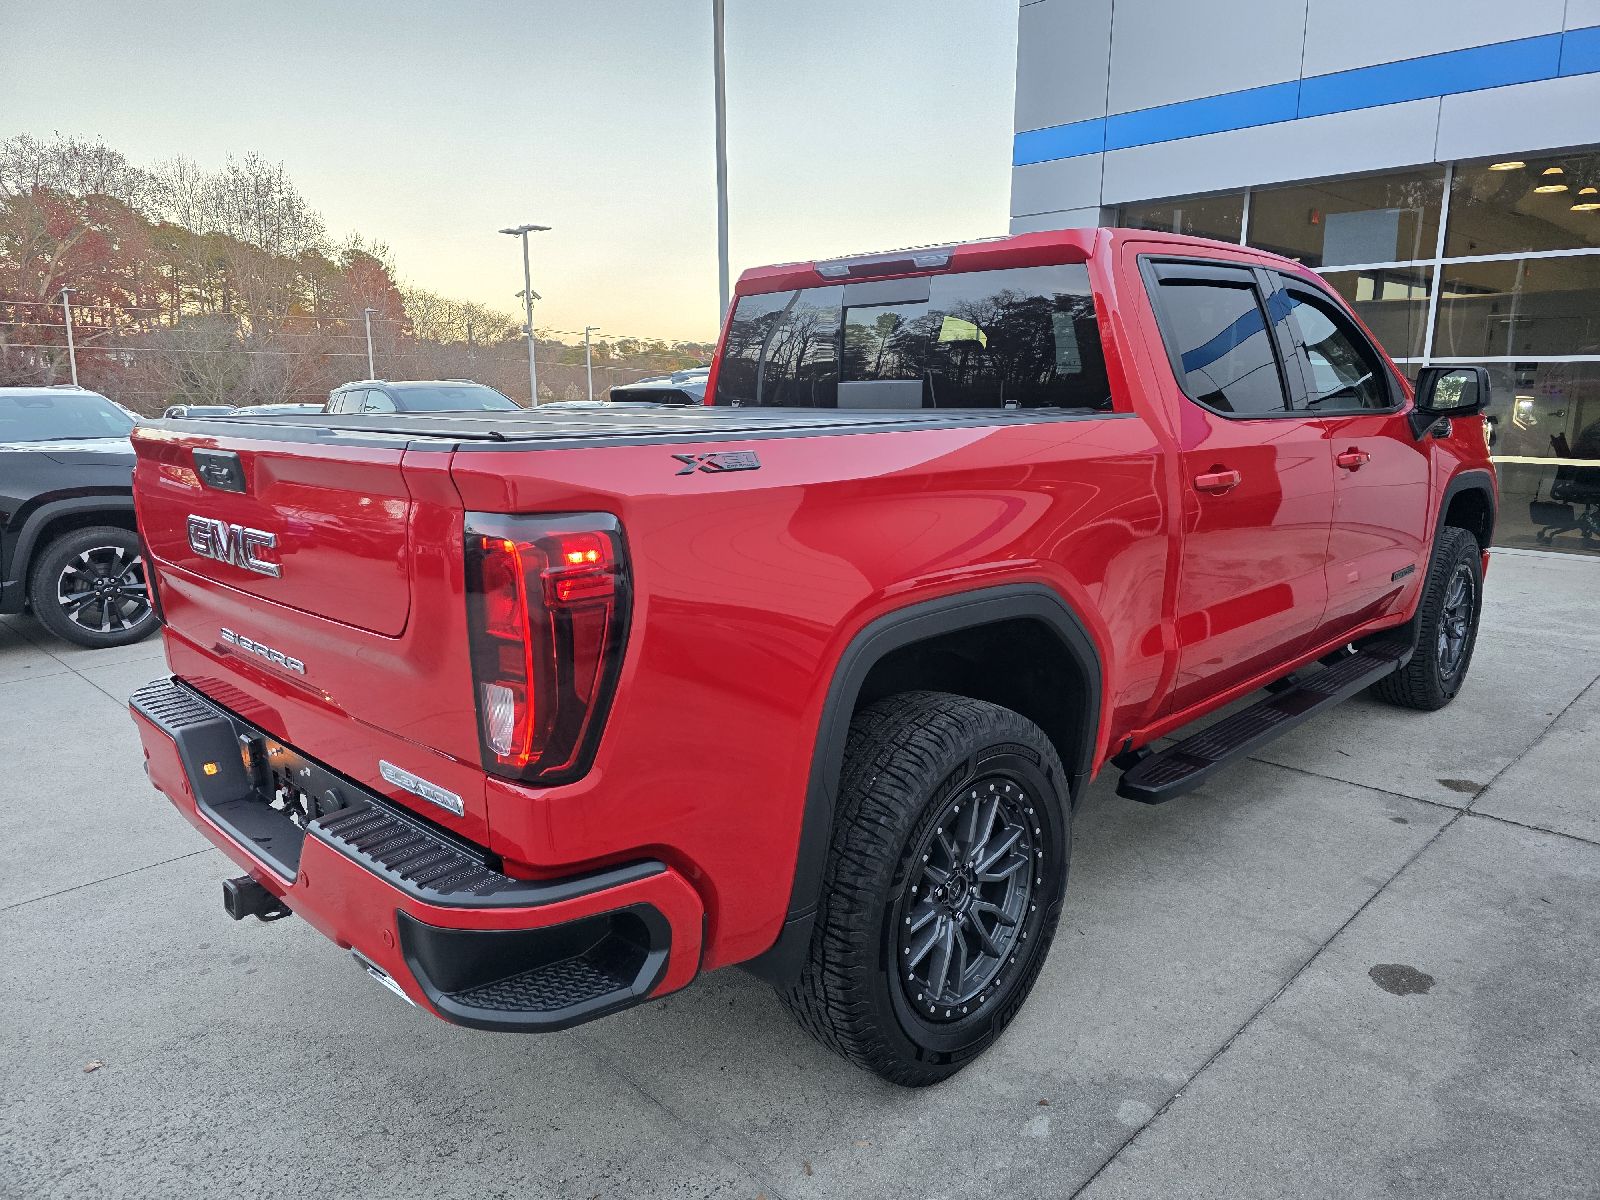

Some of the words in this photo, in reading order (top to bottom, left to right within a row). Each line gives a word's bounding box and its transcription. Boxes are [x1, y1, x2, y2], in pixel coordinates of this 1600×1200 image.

[187, 513, 281, 578] GMC
[220, 627, 305, 675] SIERRA
[384, 767, 458, 807] ELEVATION
